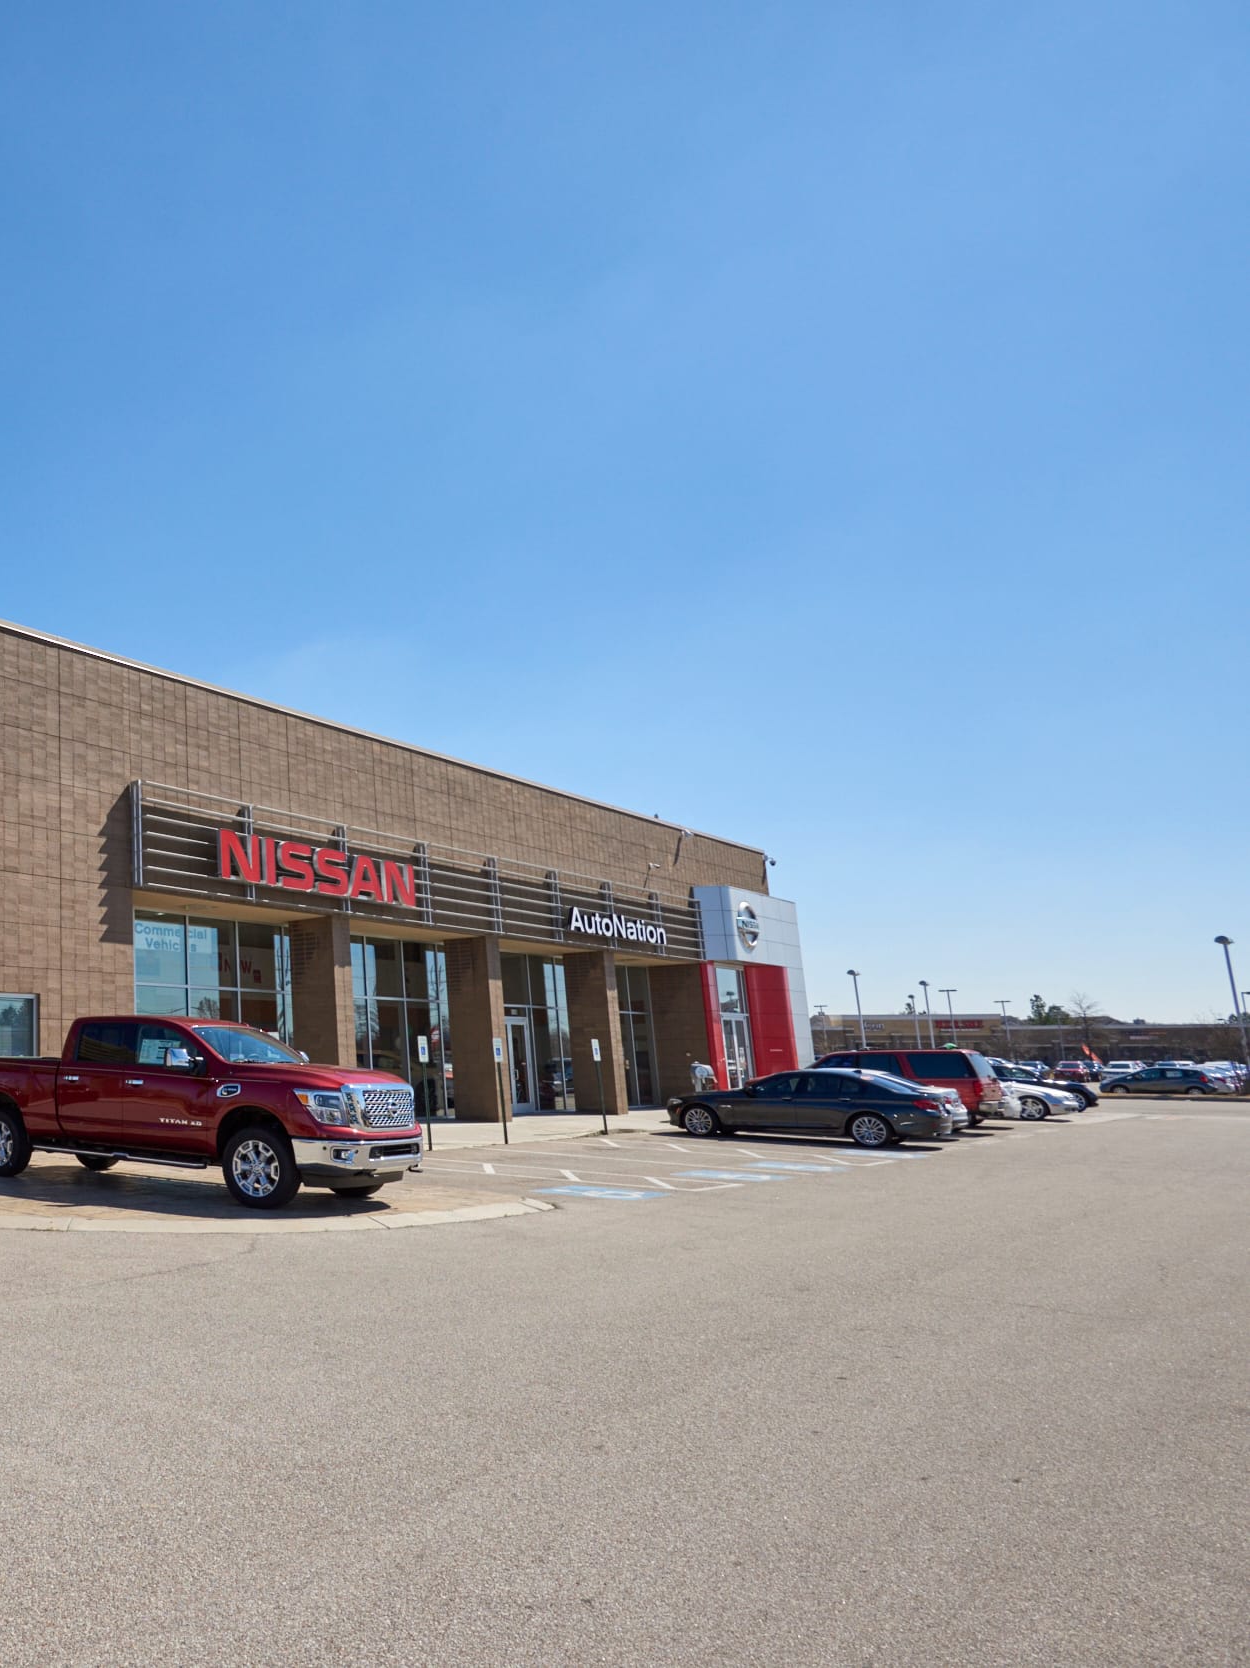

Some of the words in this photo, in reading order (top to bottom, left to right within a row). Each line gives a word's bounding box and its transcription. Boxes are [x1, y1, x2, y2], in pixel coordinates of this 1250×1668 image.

[218, 829, 417, 907] NISSAN
[134, 922, 207, 940] Commecial
[570, 906, 667, 944] AutoNation
[144, 937, 198, 953] Vehics
[159, 1117, 188, 1125] TITAN
